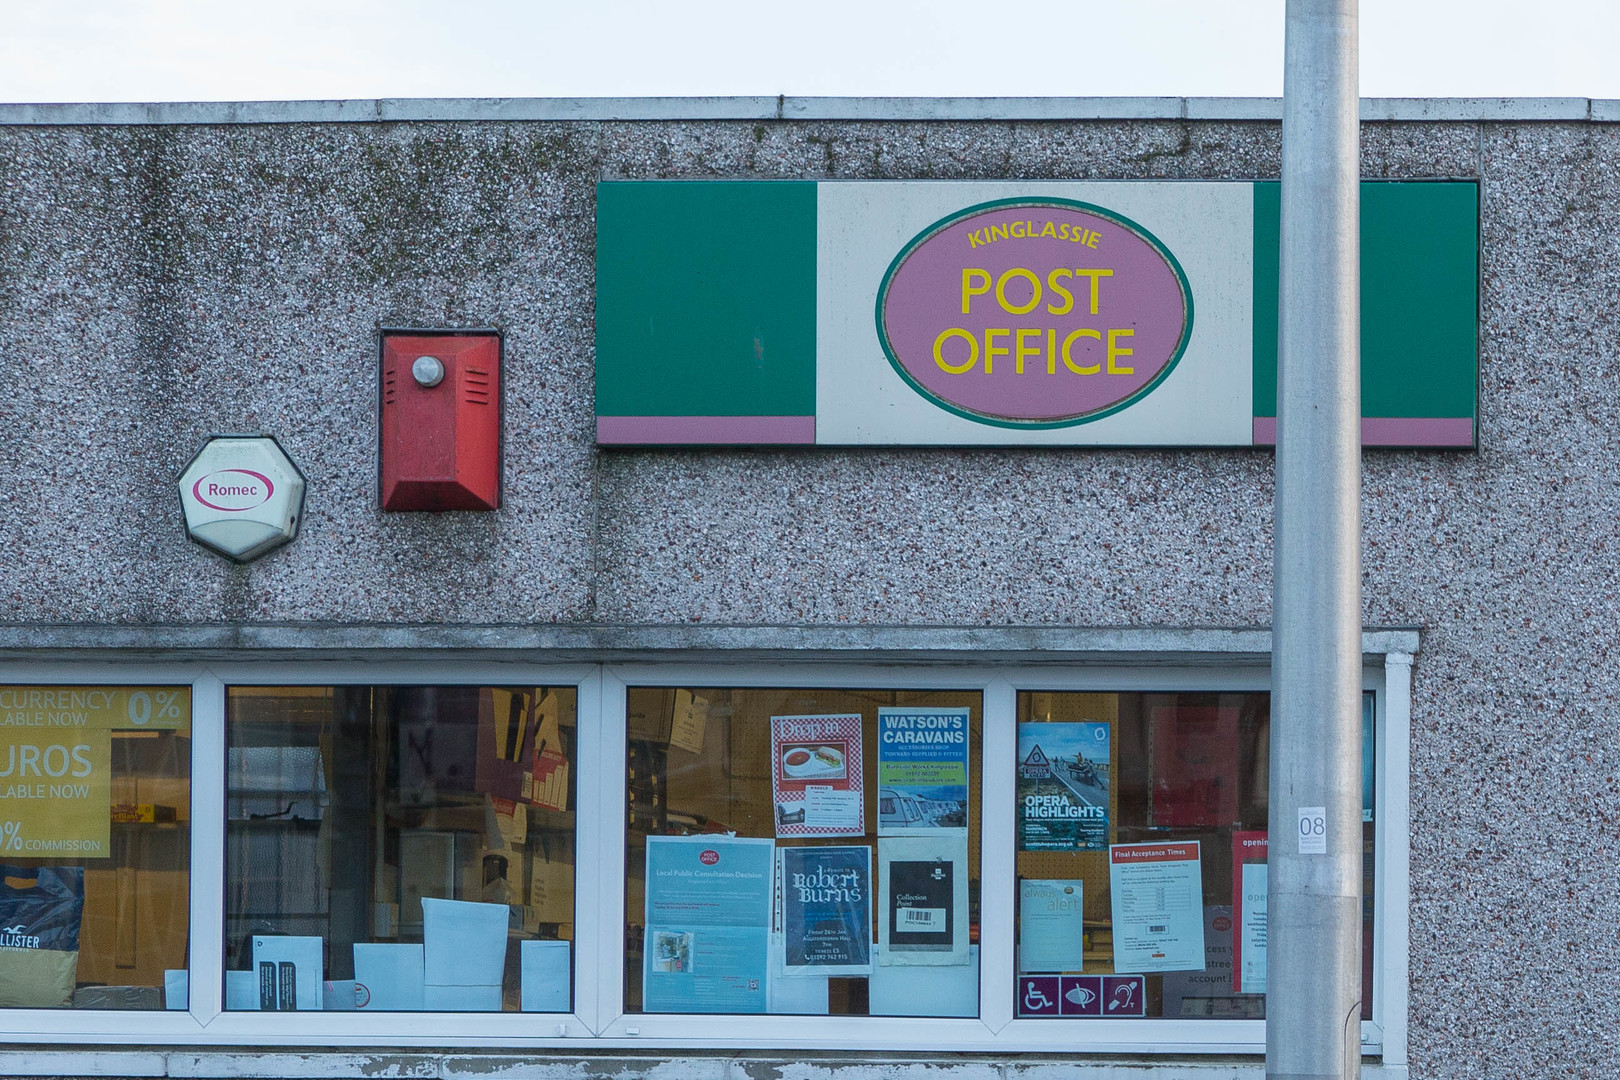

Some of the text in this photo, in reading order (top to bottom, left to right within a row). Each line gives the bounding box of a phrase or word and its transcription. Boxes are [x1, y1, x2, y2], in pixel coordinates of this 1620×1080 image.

[967, 220, 1103, 250] KINGLASSIE
[960, 268, 1114, 316] POST
[933, 327, 1135, 376] OFFICE
[208, 483, 258, 496] Romec
[0, 690, 117, 710] CURRENCY
[48, 711, 88, 727] NOW
[884, 716, 963, 729] WATSON'S
[779, 720, 820, 740] Drop
[883, 730, 965, 744] CARAVANS
[50, 784, 90, 799] NOW
[1025, 795, 1070, 807] OPERA
[1025, 806, 1105, 818] HIGHLIGHTS
[1300, 817, 1325, 836] 08
[25, 839, 101, 851] COMMISSION
[1131, 850, 1166, 858] Acceptance
[1167, 848, 1186, 856] Times
[656, 869, 763, 879] Local Public Consultation Decision
[792, 864, 860, 888] Robert
[798, 887, 862, 903] Burns
[1024, 888, 1057, 899] always
[1047, 898, 1080, 912] alert
[1188, 975, 1227, 983] account
